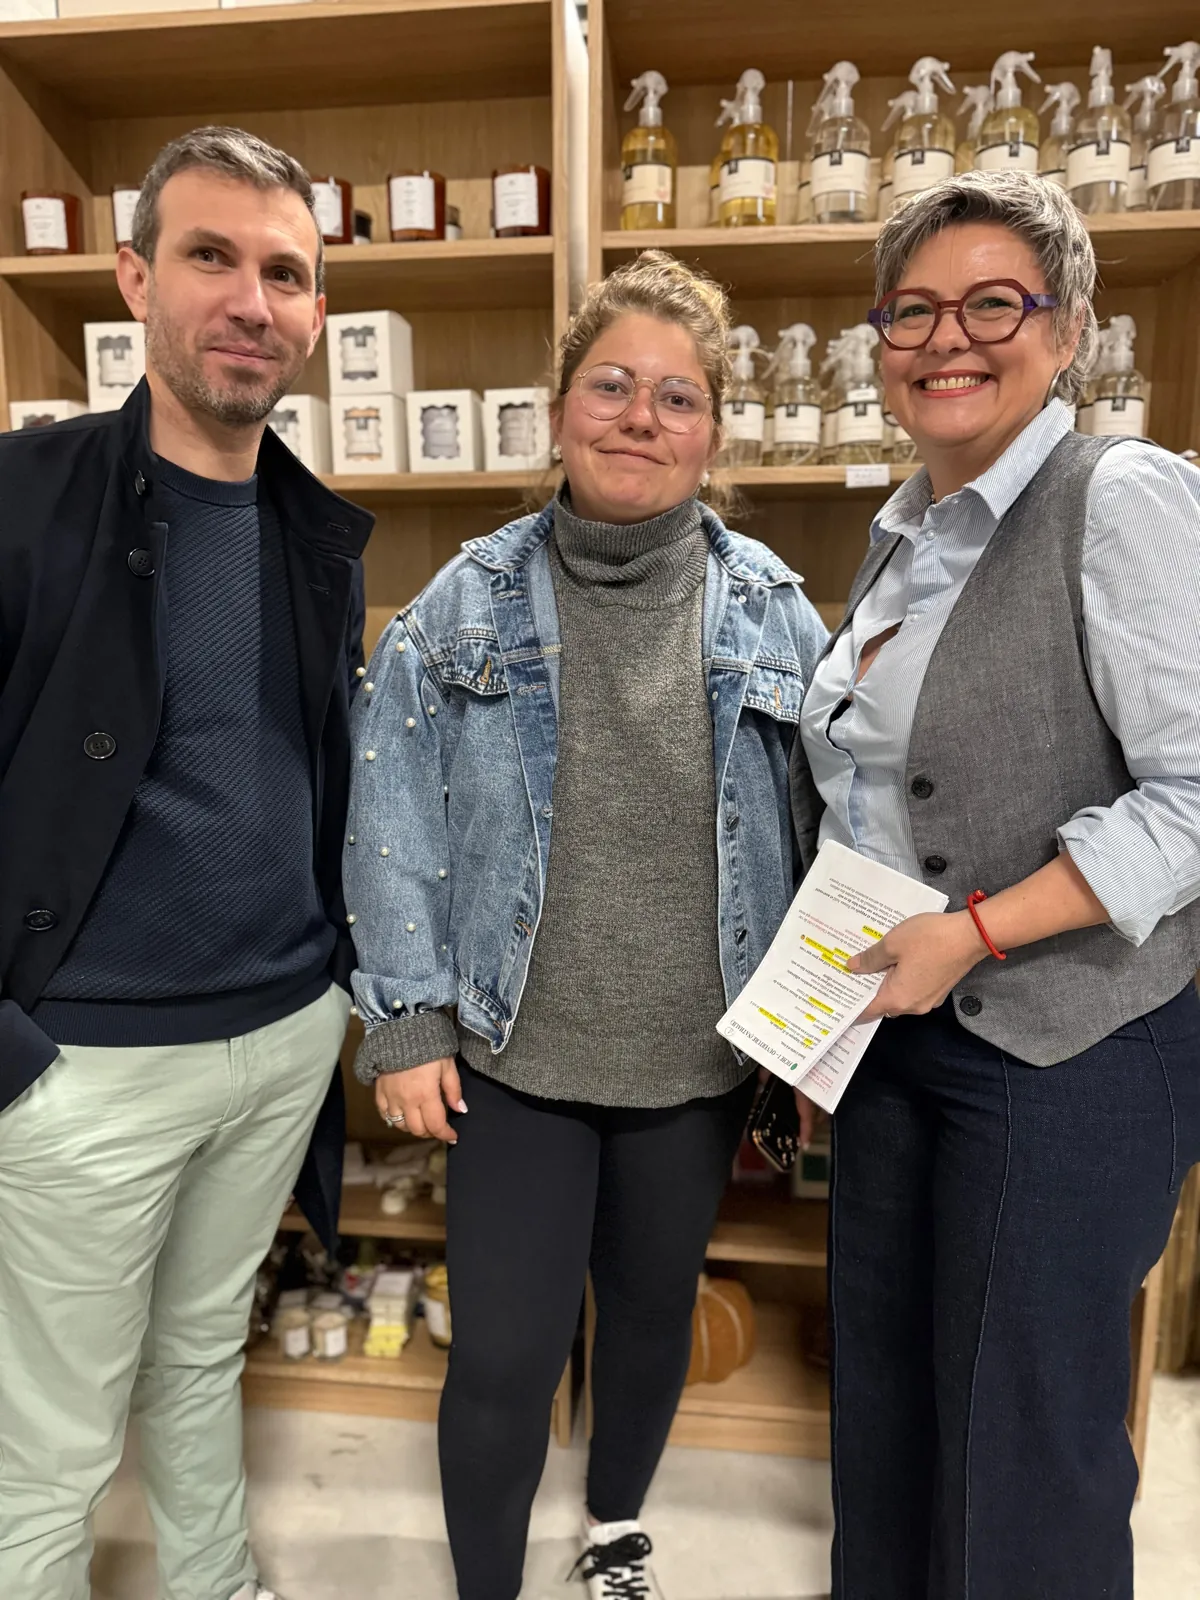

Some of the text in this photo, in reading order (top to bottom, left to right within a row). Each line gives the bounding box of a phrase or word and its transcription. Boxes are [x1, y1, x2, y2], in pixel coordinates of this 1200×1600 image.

[730, 1018, 753, 1039] (NATHALIE)
[752, 1036, 776, 1056] OUVERTURE
[780, 1055, 793, 1067] FICHE
